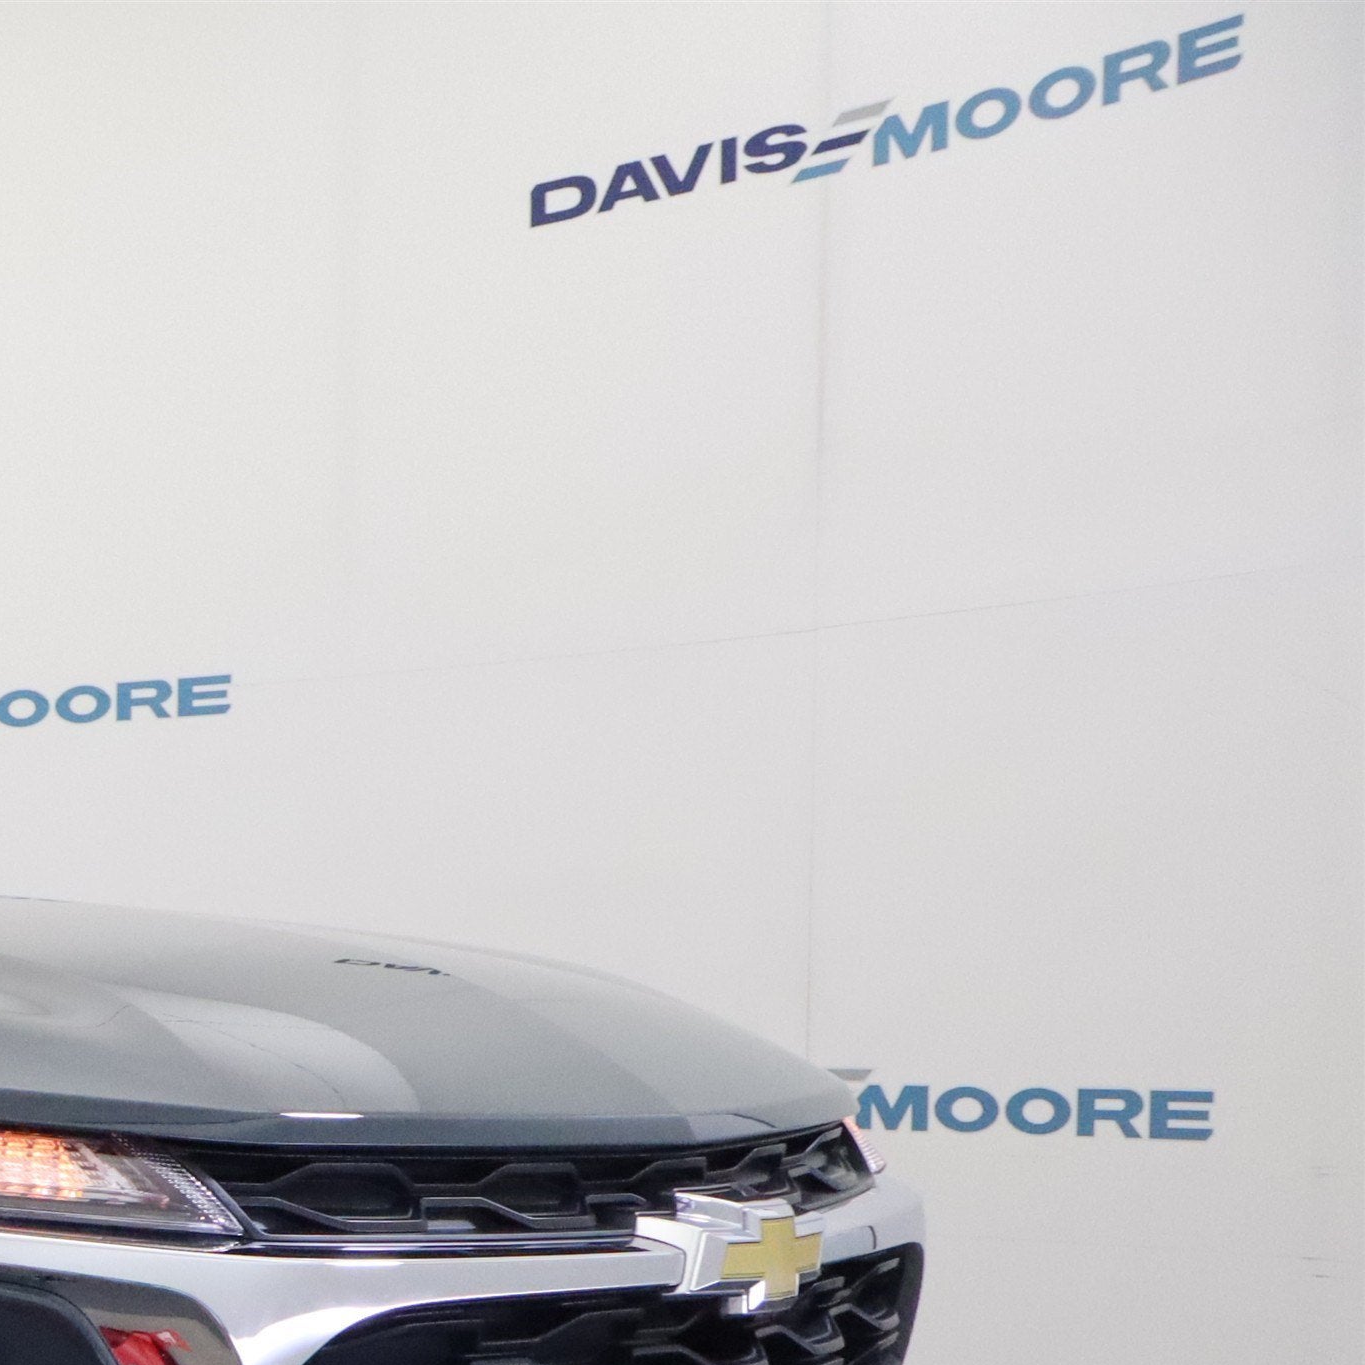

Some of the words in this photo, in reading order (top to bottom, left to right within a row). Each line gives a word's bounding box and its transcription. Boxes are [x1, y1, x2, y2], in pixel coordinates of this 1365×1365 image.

[530, 123, 808, 228] DAVIS
[872, 13, 1246, 168] MOORE
[856, 1084, 1214, 1141] MOORE
